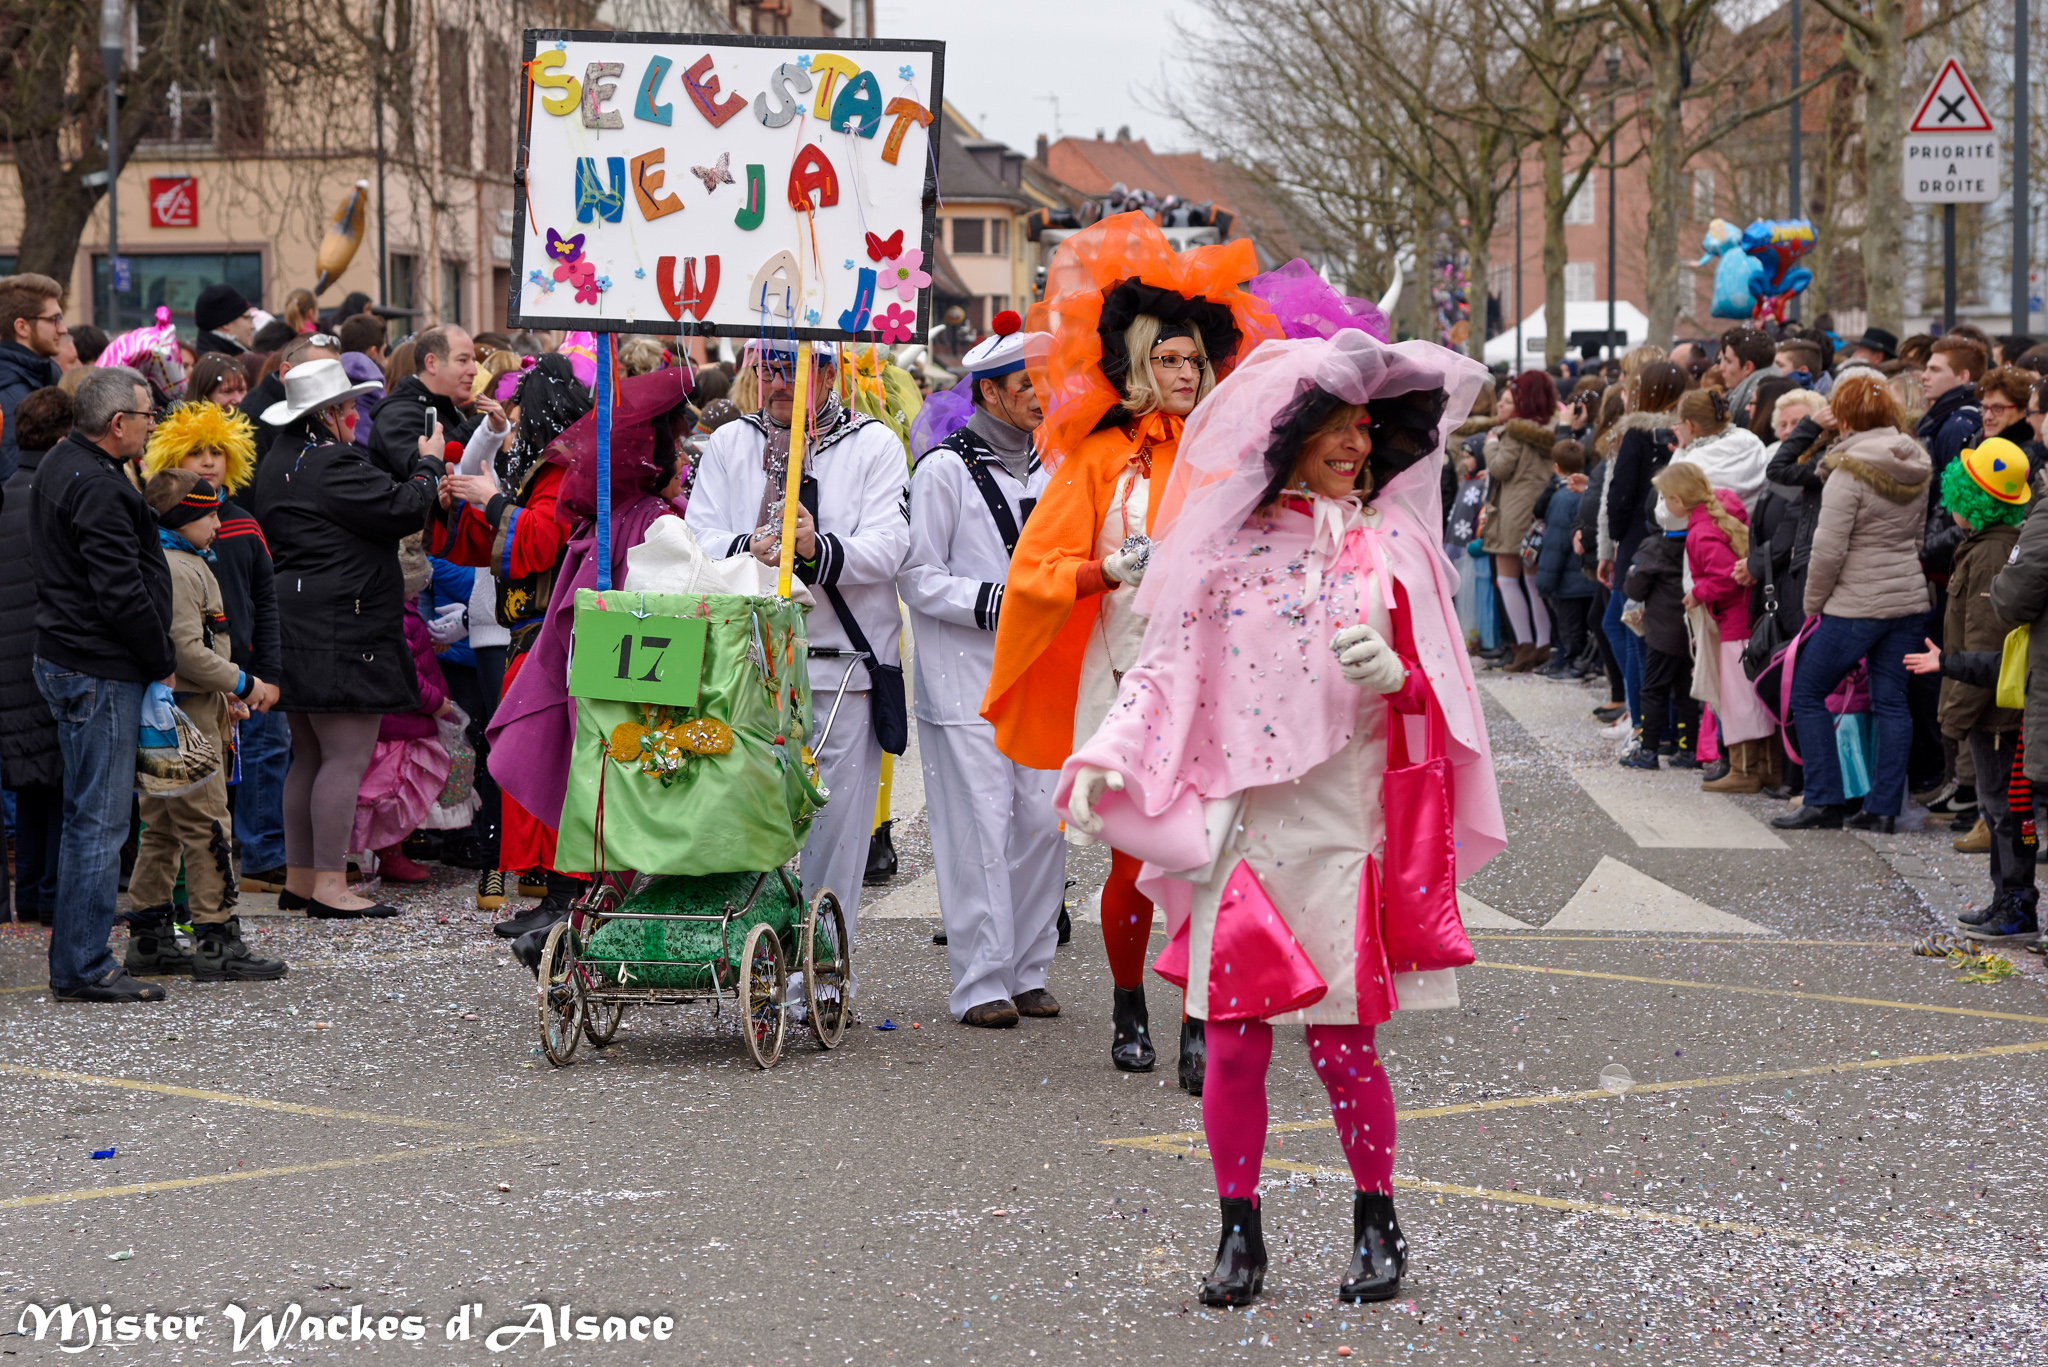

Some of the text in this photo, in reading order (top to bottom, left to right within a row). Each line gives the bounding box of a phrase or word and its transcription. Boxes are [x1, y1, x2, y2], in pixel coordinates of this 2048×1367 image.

[531, 50, 935, 166] SELESTAT
[1909, 143, 1995, 158] PRIORITÉ
[1947, 162, 1957, 175] A
[575, 143, 839, 230] NE JA
[1919, 179, 1985, 192] DROITE
[656, 249, 877, 333] WAJ
[612, 634, 672, 683] 17
